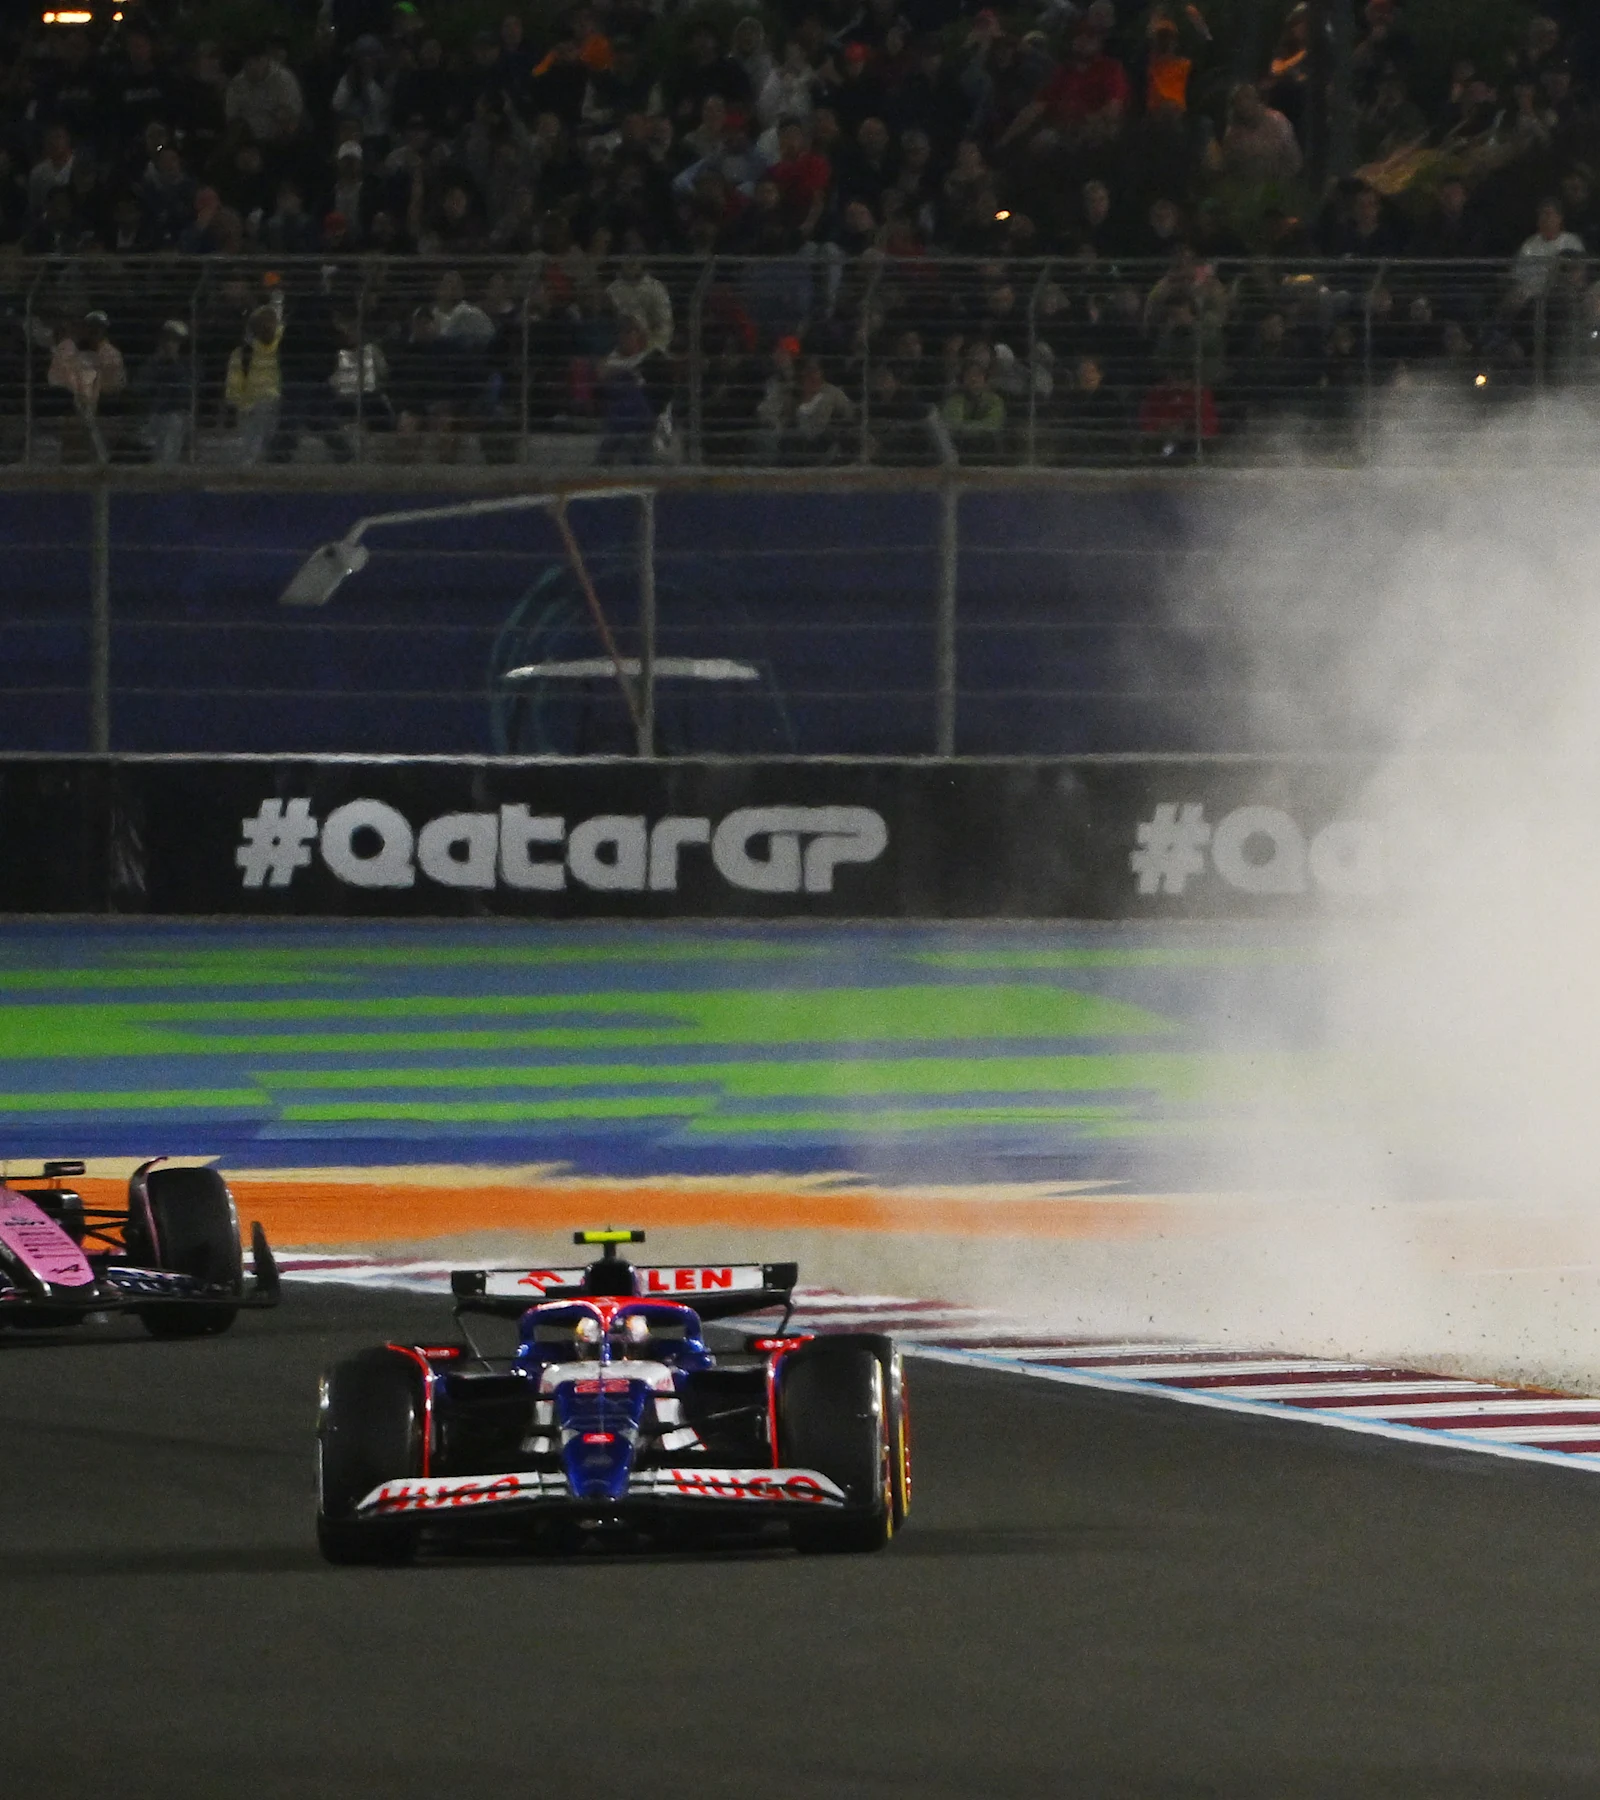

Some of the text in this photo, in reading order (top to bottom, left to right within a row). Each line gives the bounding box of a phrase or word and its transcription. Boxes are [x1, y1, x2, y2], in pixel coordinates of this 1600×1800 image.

[235, 797, 888, 893] #QatarGP
[640, 1267, 733, 1292] LEN
[376, 1474, 520, 1513] HUGO
[670, 1468, 824, 1503] HUGO
